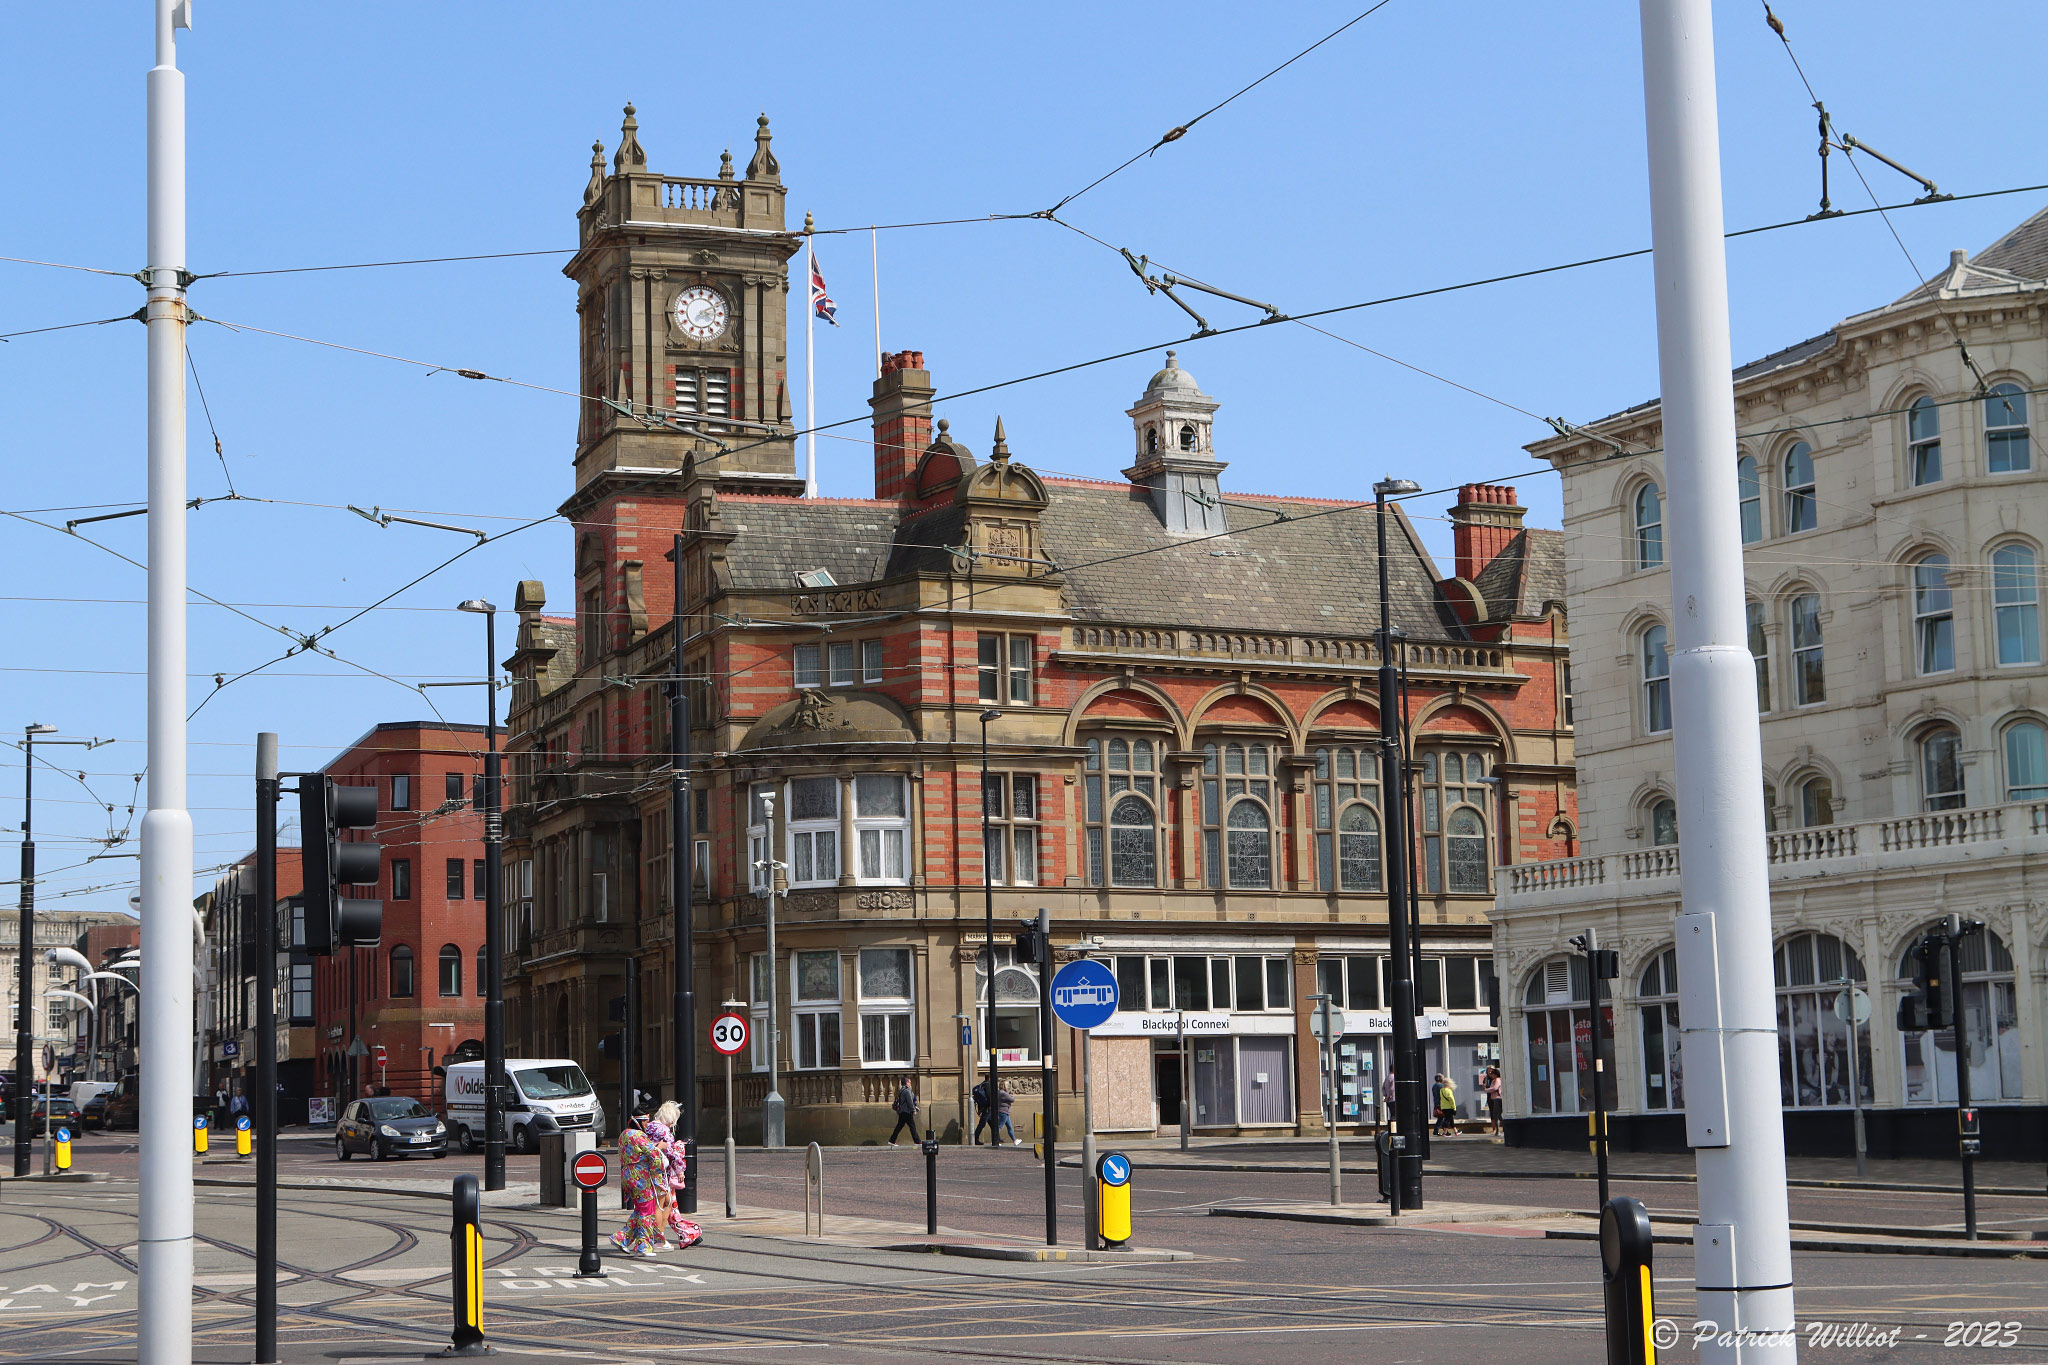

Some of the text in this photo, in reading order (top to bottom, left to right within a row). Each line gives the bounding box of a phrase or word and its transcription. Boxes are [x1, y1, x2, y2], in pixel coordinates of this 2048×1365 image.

[1369, 1018, 1393, 1028] Black
[715, 1025, 743, 1042] 30
[455, 1075, 486, 1095] Volde
[483, 1264, 687, 1277] TRAM
[0, 1281, 128, 1294] AM
[499, 1273, 707, 1289] ONLY
[0, 1294, 118, 1310] LY
